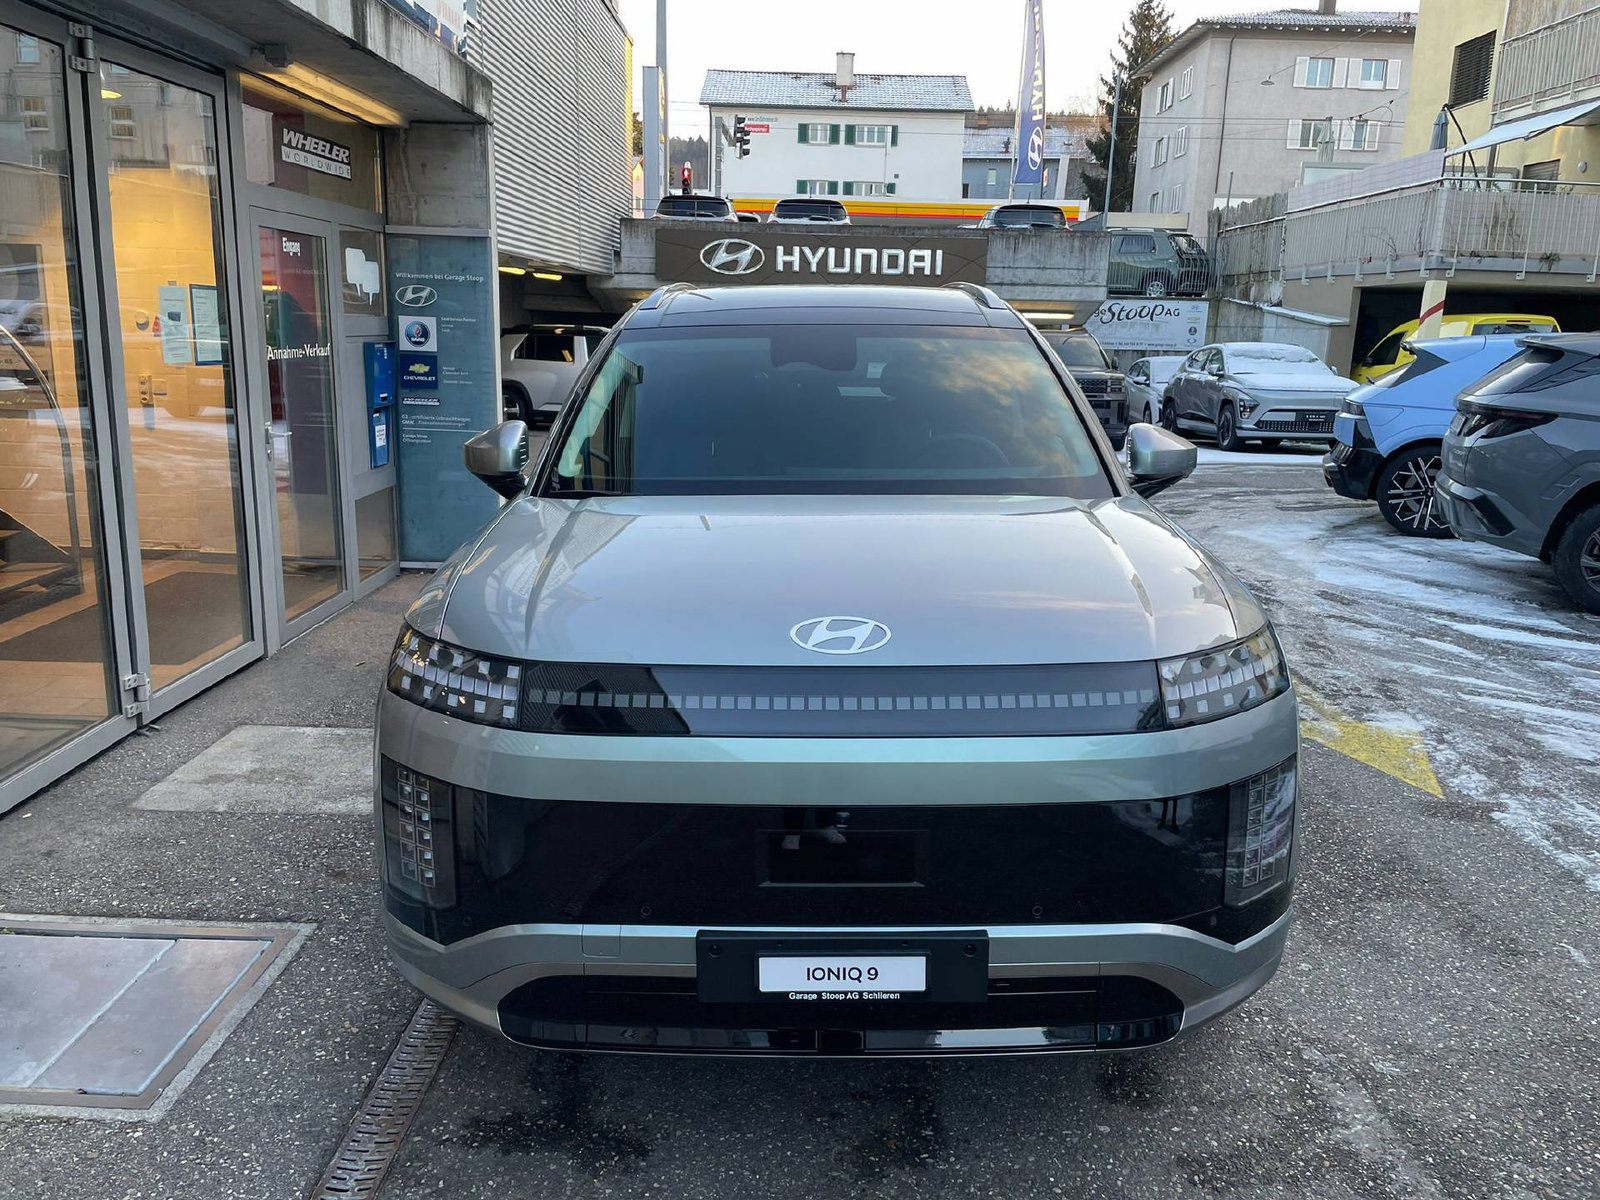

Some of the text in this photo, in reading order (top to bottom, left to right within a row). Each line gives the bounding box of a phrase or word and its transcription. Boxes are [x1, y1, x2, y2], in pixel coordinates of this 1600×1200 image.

[283, 128, 350, 163] WHEELER
[283, 149, 350, 177] WORLDWIDE
[282, 237, 301, 256] Eingang
[775, 245, 943, 276] HYUNDAI
[444, 274, 465, 282] Garage
[466, 274, 484, 282] Stoop
[1100, 302, 1165, 325] Stoop
[1164, 308, 1180, 317] AG
[267, 343, 331, 361] Annahme-Verkauf
[806, 967, 879, 984] IONIQ 9
[789, 991, 900, 1001] Garage Stoop AG Schlieren
